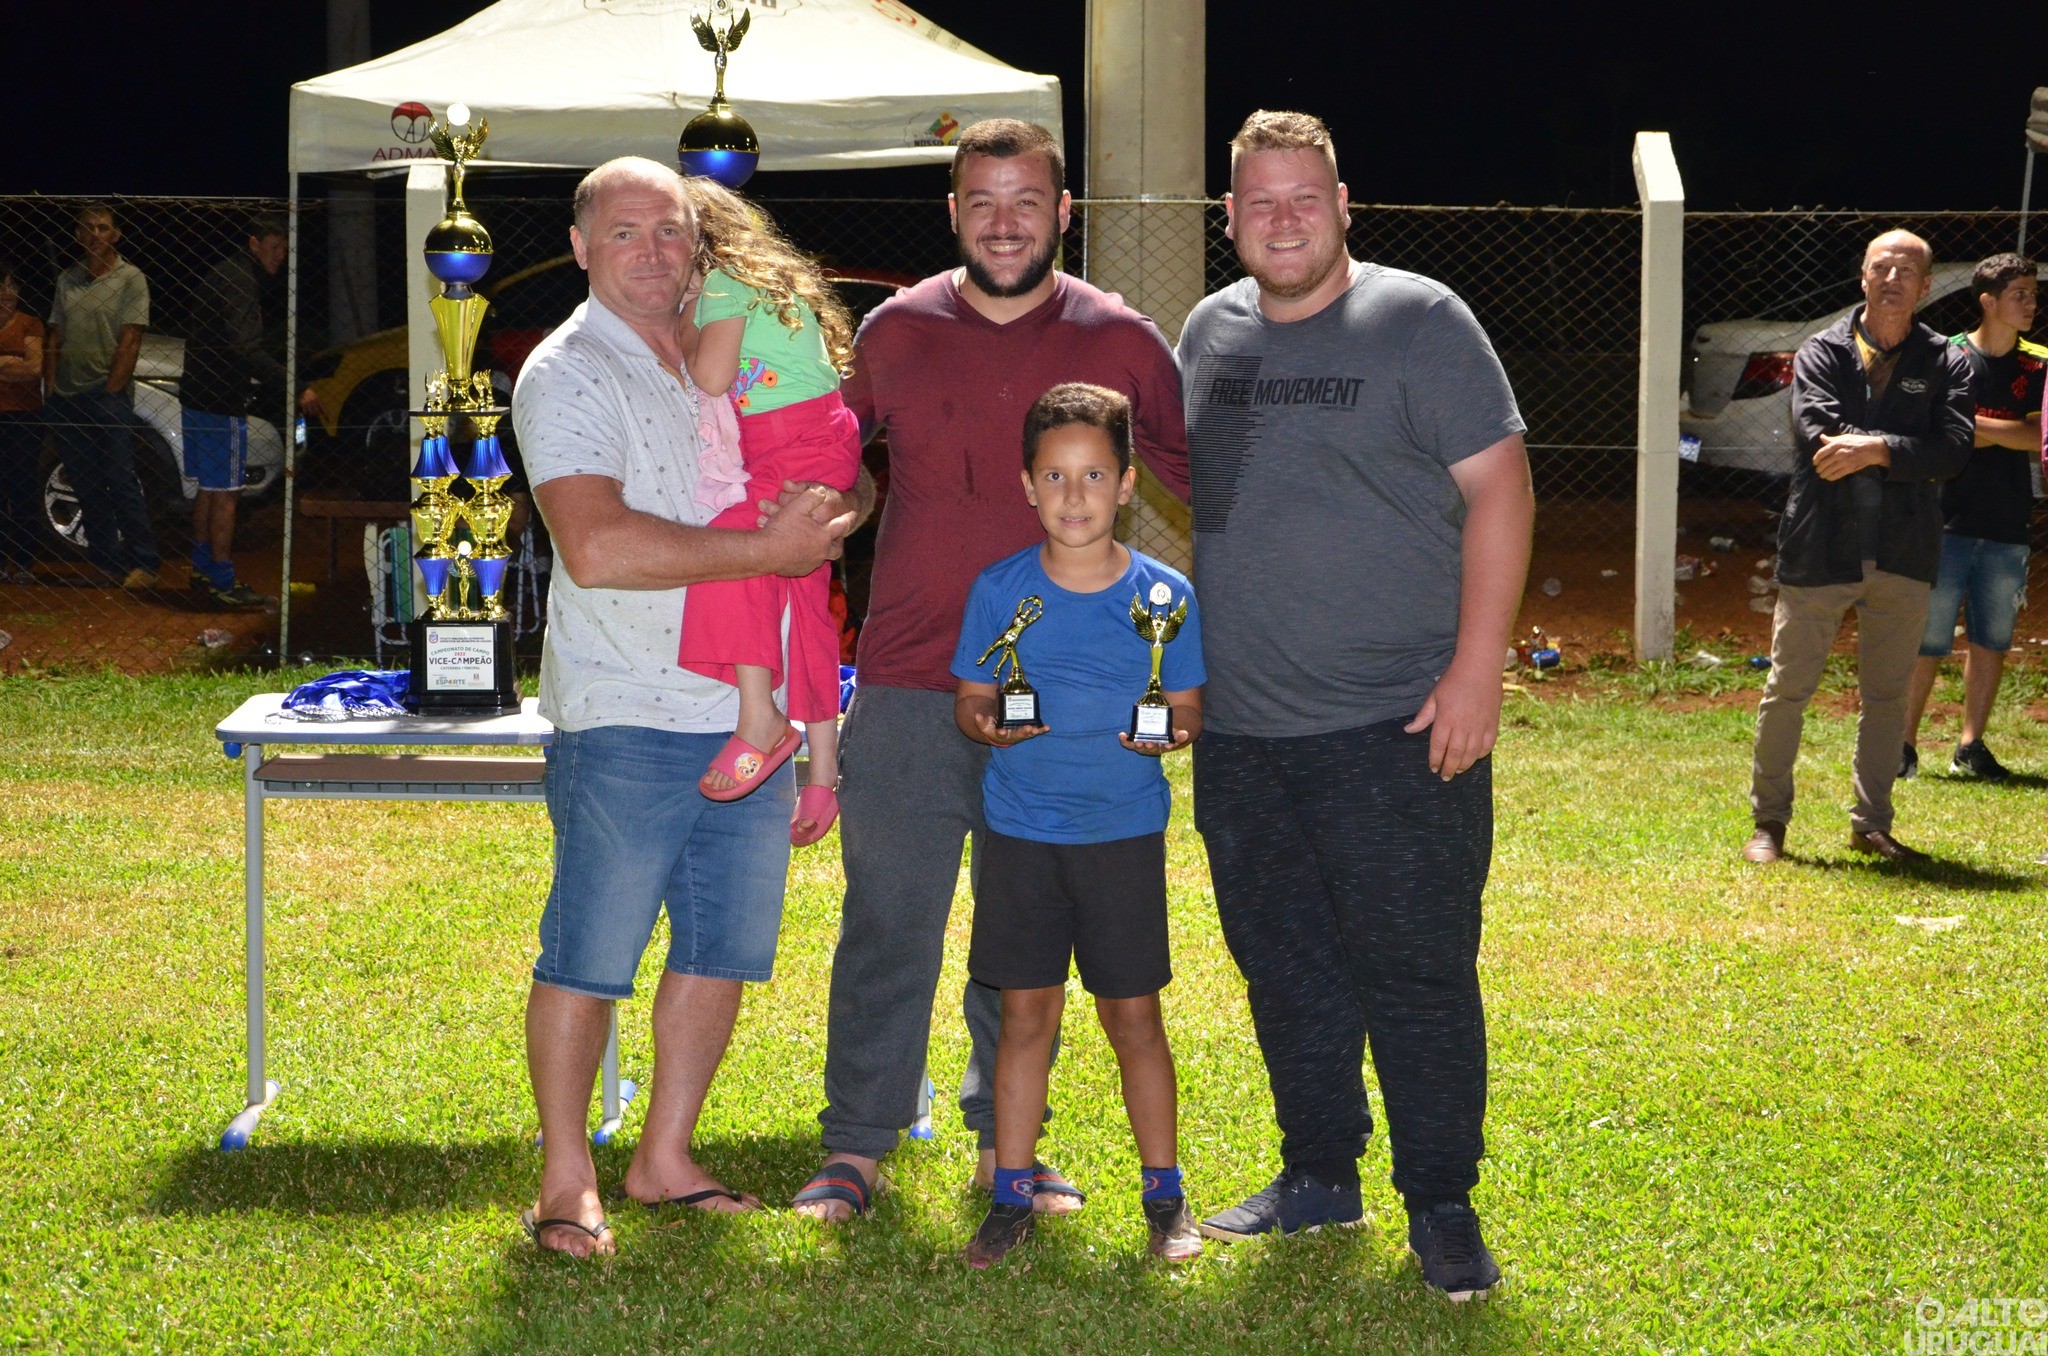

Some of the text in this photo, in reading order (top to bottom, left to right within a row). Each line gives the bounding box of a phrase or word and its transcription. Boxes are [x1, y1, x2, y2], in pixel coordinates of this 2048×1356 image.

[372, 147, 438, 161] ADMA
[1208, 377, 1366, 407] FREE MOVEMENT
[431, 646, 464, 656] CAMPEONATO
[472, 647, 490, 656] CAMPO
[429, 655, 492, 665] VICE-CAMPEÃO
